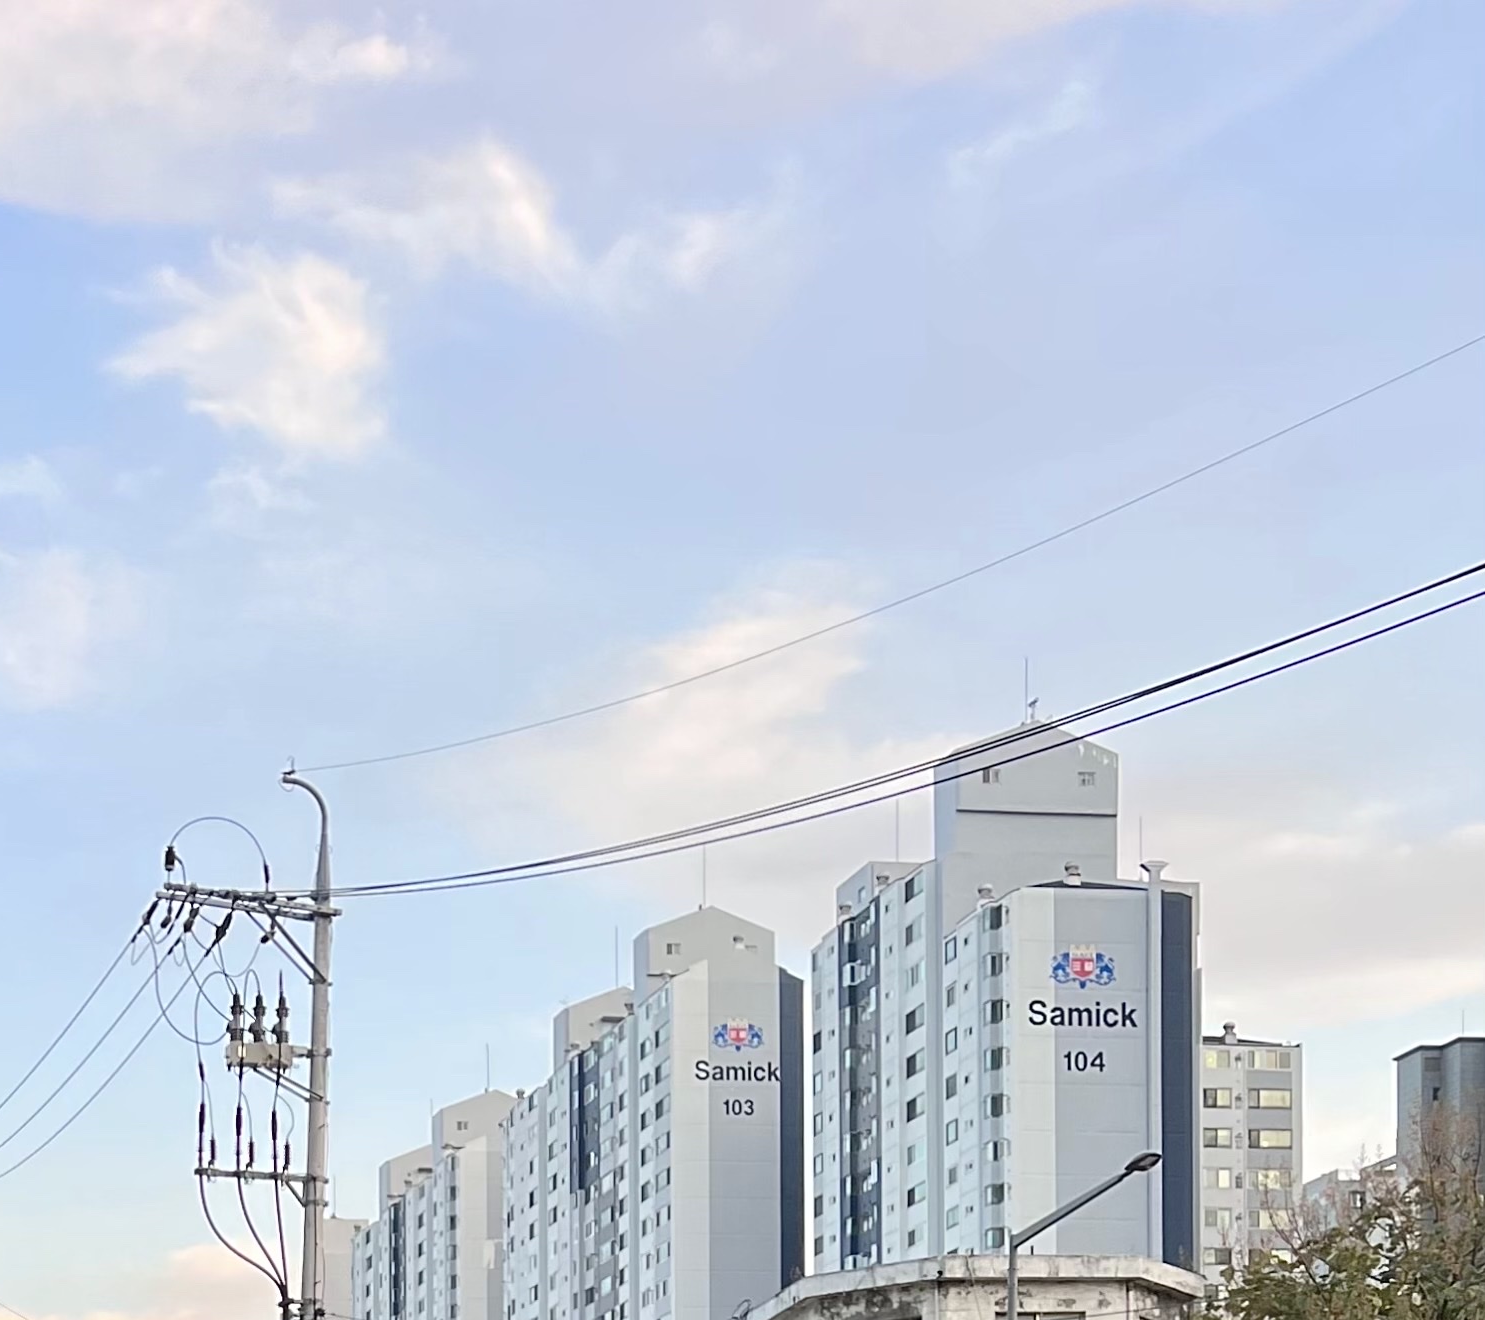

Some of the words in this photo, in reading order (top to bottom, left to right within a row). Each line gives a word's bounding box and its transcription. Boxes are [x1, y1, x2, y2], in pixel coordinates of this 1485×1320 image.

[1028, 999, 1138, 1028] Samick
[694, 1059, 781, 1082] Samick
[1062, 1051, 1107, 1073] 104
[722, 1098, 755, 1117] 103
